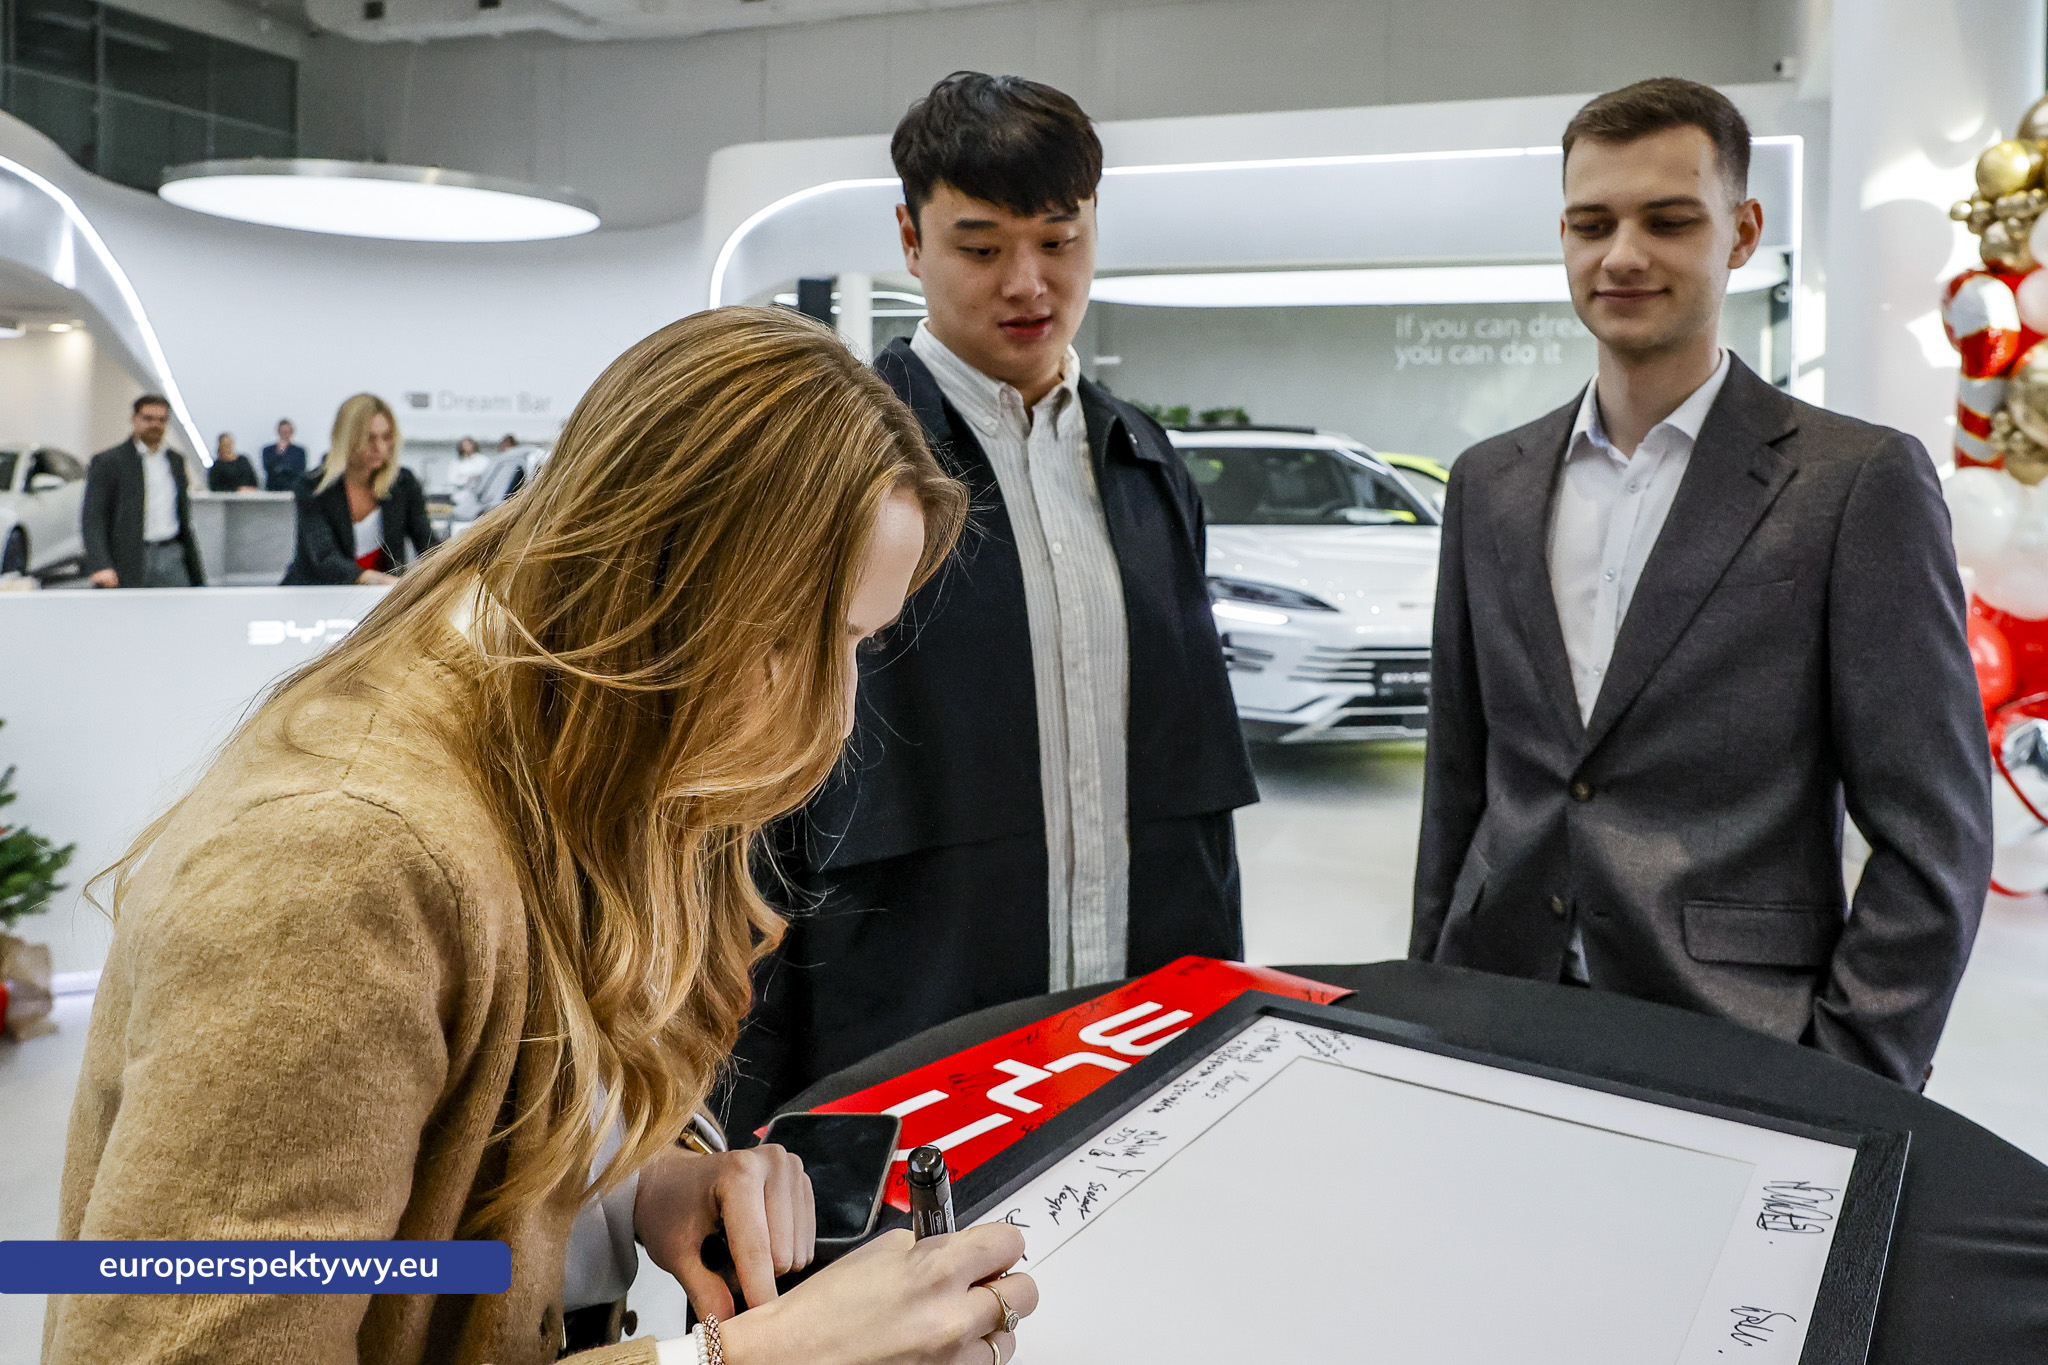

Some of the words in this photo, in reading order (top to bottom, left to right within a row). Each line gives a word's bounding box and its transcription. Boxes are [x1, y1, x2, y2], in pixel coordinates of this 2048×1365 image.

[1396, 313, 1414, 338] If
[1420, 318, 1467, 345] you
[1474, 318, 1521, 338] can
[1527, 313, 1592, 338] drea
[1395, 346, 1442, 371] you
[1448, 346, 1494, 364] can
[1501, 341, 1536, 364] do
[1543, 343, 1562, 364] it
[438, 391, 513, 412] Dream
[517, 391, 551, 412] Bar
